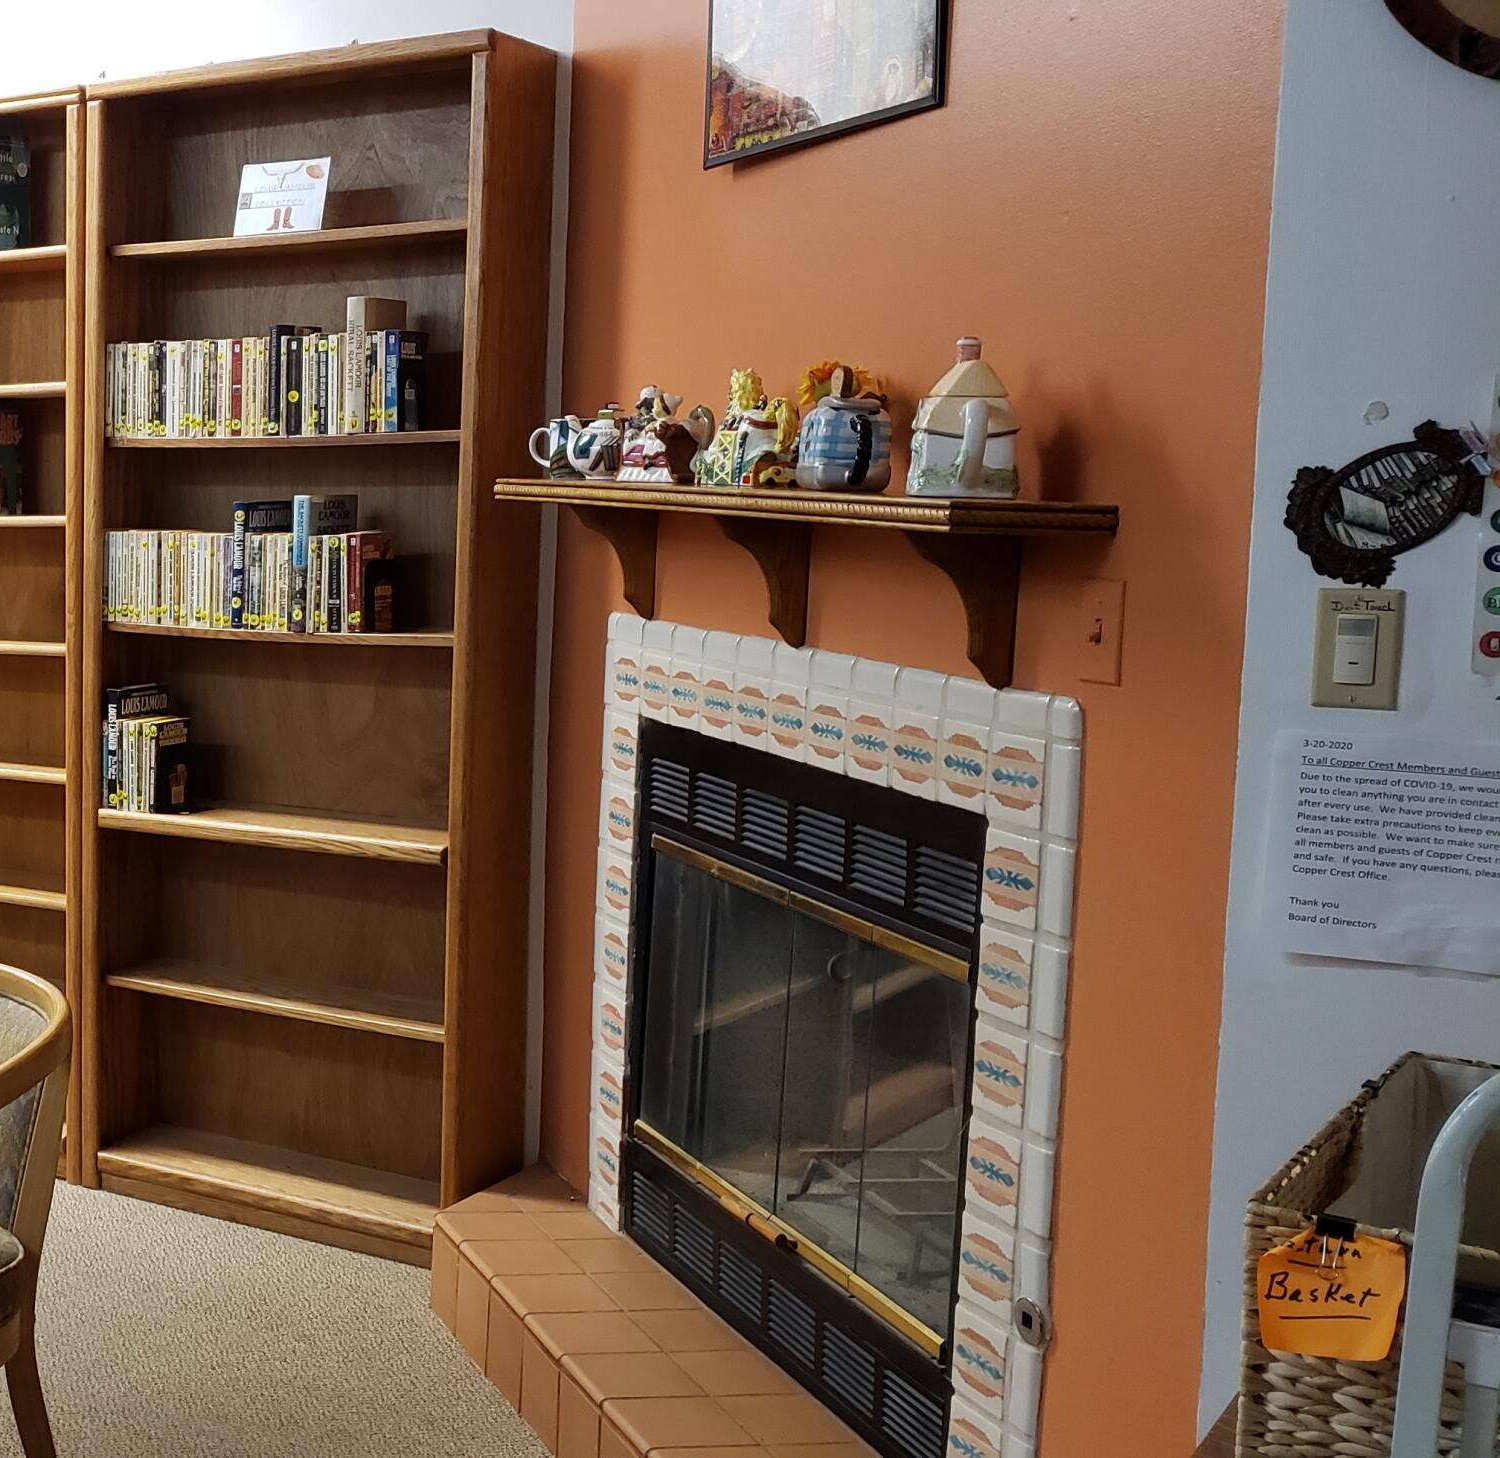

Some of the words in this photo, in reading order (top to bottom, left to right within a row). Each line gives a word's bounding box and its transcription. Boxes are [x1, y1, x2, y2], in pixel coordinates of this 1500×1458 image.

[354, 325, 363, 349] LOUIS
[354, 352, 363, 388] L'AMOUR
[234, 521, 243, 541] LOUIS
[233, 542, 243, 569] L'AMOUR
[121, 697, 140, 714] LOUIS
[1303, 739, 1353, 750] 3-20-2020
[1302, 755, 1314, 764] To
[1316, 757, 1327, 765] all
[1330, 758, 1365, 767] Copper
[1368, 760, 1394, 769] Crest
[1397, 762, 1445, 774] Members
[1448, 766, 1468, 775] and
[1300, 771, 1320, 780] Due
[1335, 775, 1352, 783] the
[1355, 777, 1388, 786] spread
[1390, 779, 1401, 787] of
[1404, 780, 1456, 792] COVID-19,
[1299, 786, 1317, 794] you
[1320, 787, 1330, 795] to
[1332, 788, 1358, 797] clean
[1361, 792, 1403, 803] anything
[1407, 795, 1426, 803] you
[1428, 796, 1445, 804] are
[1448, 797, 1457, 805] in
[1460, 799, 1499, 808] contact
[1298, 799, 1321, 808] after
[1324, 801, 1351, 812] every
[1380, 805, 1396, 814] We
[1399, 807, 1423, 816] have
[1426, 809, 1471, 820] provided
[1297, 812, 1327, 821] Please
[1330, 815, 1352, 824] take
[1354, 817, 1380, 826] extra
[1382, 818, 1442, 830] precautions
[1445, 824, 1456, 832] to
[1459, 824, 1483, 836] keep
[1296, 826, 1321, 834] clean
[1337, 830, 1379, 839] possible.
[1389, 833, 1403, 841] We
[1406, 835, 1431, 844] want
[1434, 837, 1444, 845] to
[1447, 838, 1475, 848] make
[1478, 842, 1500, 850] sure
[1309, 840, 1355, 850] members
[1378, 847, 1410, 855] guests
[1426, 849, 1463, 860] Copper
[1466, 853, 1492, 863] Crest
[1292, 865, 1327, 875] Copper
[1330, 868, 1355, 878] Crest
[1358, 870, 1390, 881] Office.
[1373, 858, 1397, 868] have
[1399, 862, 1418, 871] any
[1421, 864, 1472, 877] questions,
[1289, 896, 1319, 906] Thank
[1321, 901, 1340, 909] you
[1288, 912, 1317, 923] Board
[1319, 916, 1330, 924] of
[1332, 917, 1377, 929] Directors
[1265, 1271, 1381, 1307] Basket
